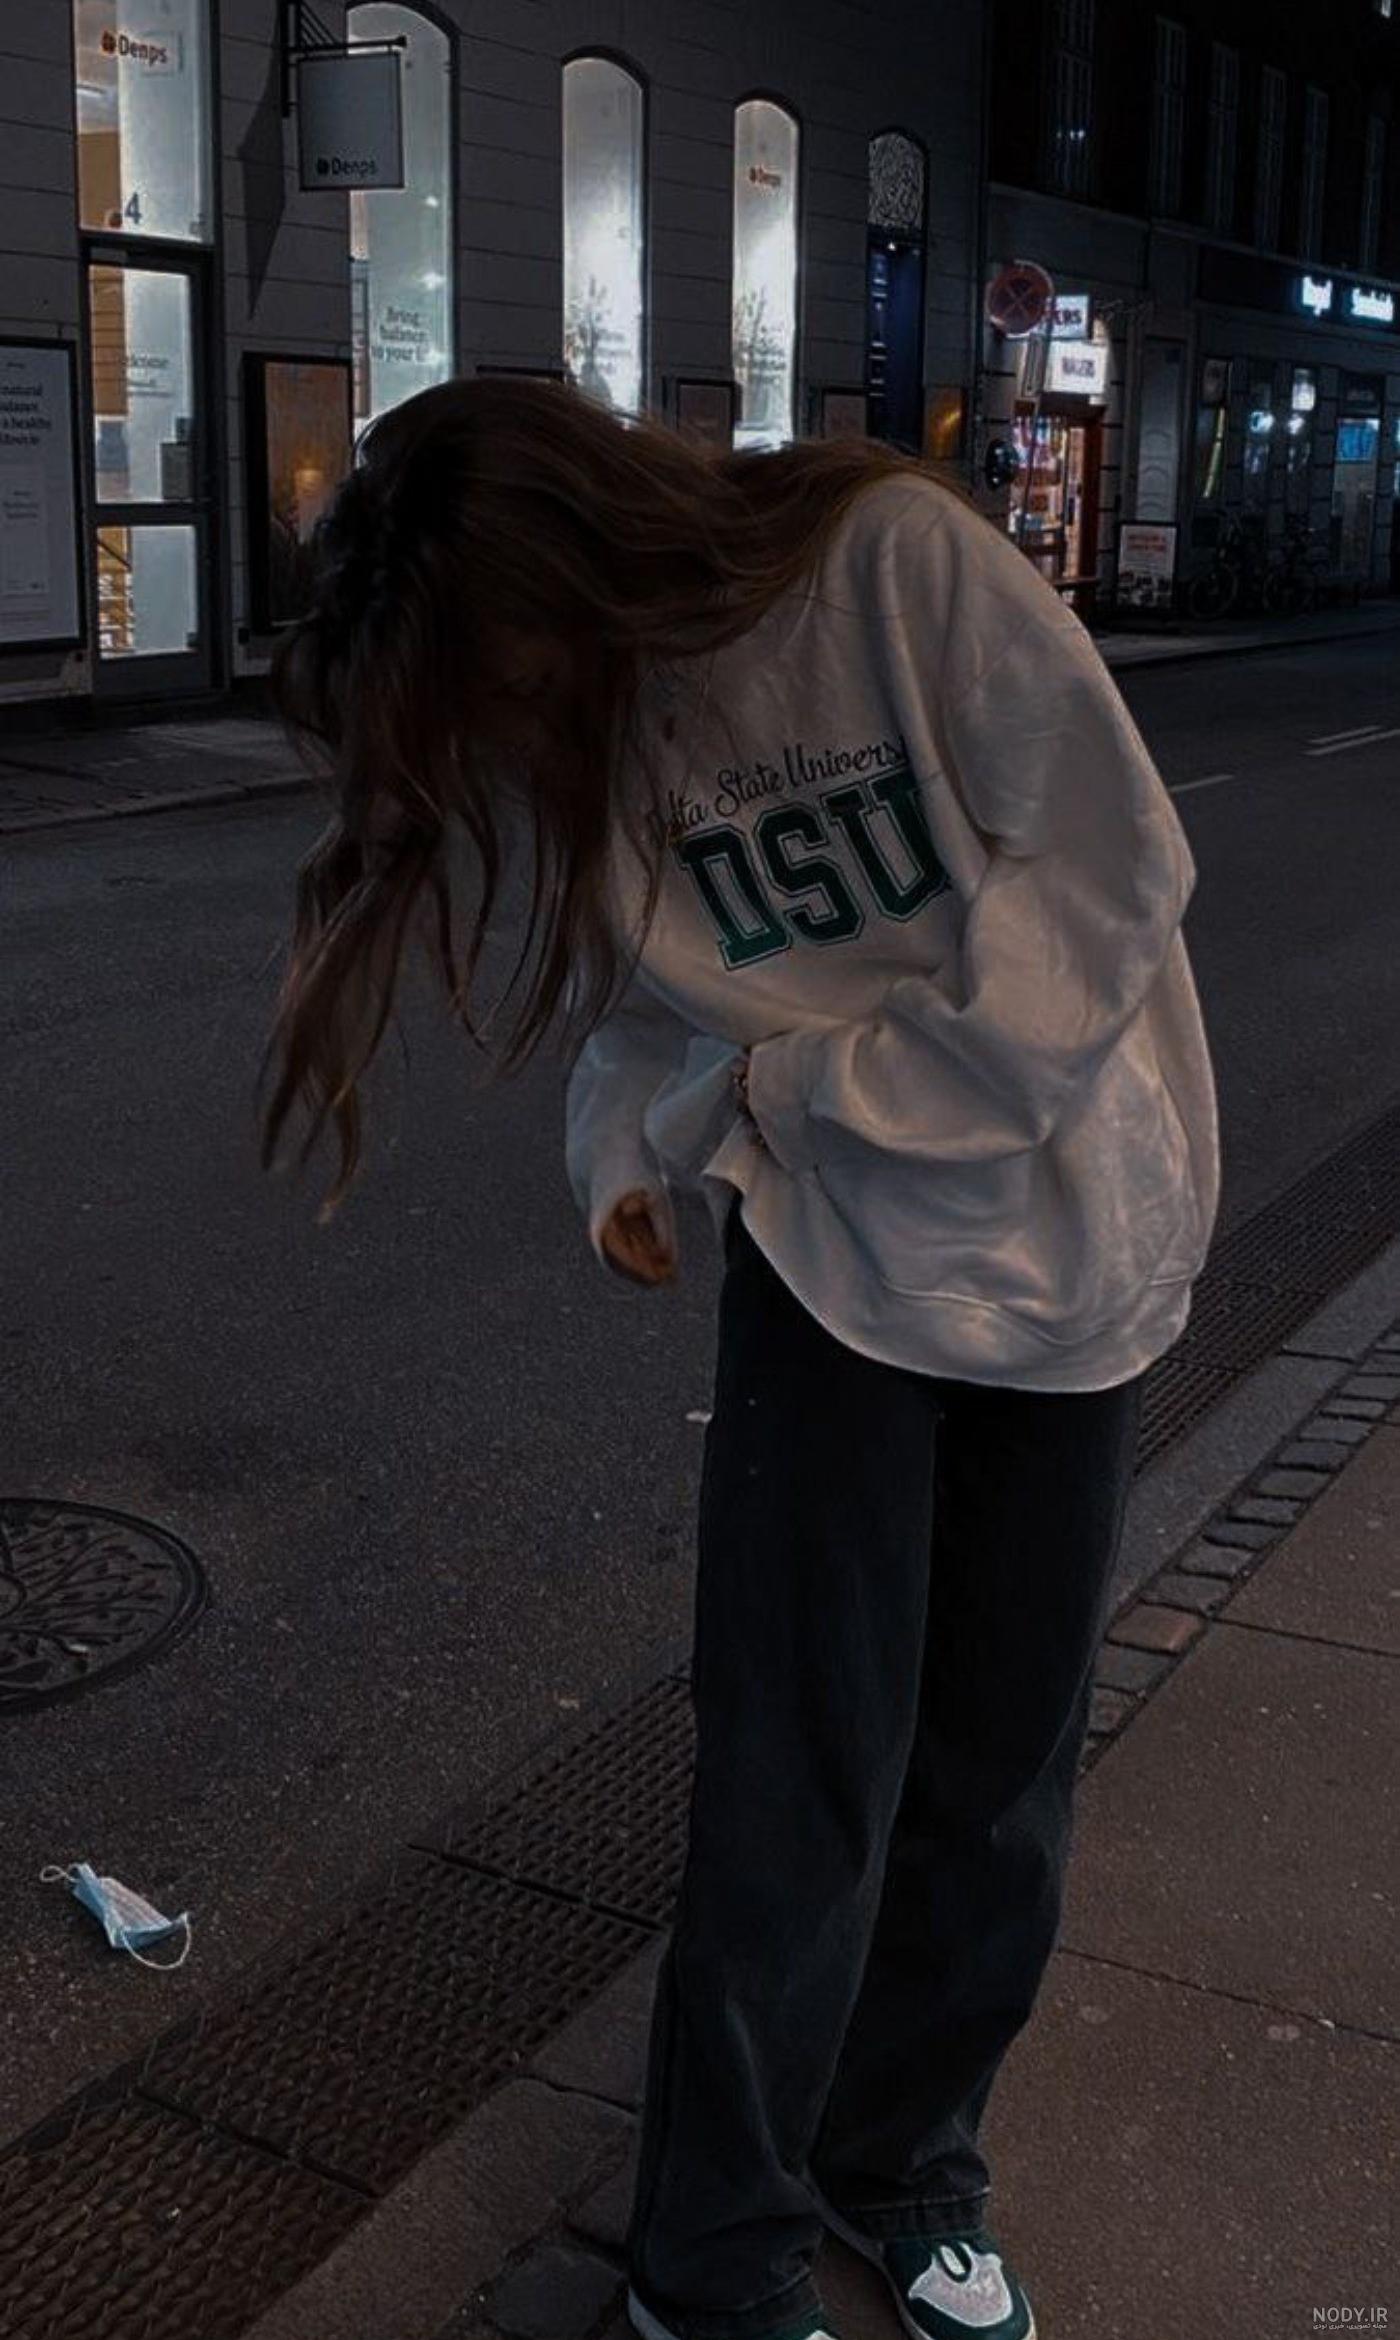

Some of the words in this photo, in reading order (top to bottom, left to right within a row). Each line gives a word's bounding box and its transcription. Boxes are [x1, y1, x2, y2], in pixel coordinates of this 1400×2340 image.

[118, 34, 168, 67] Denps
[125, 192, 142, 225] 4
[715, 763, 785, 817] State
[673, 766, 952, 971] DSU
